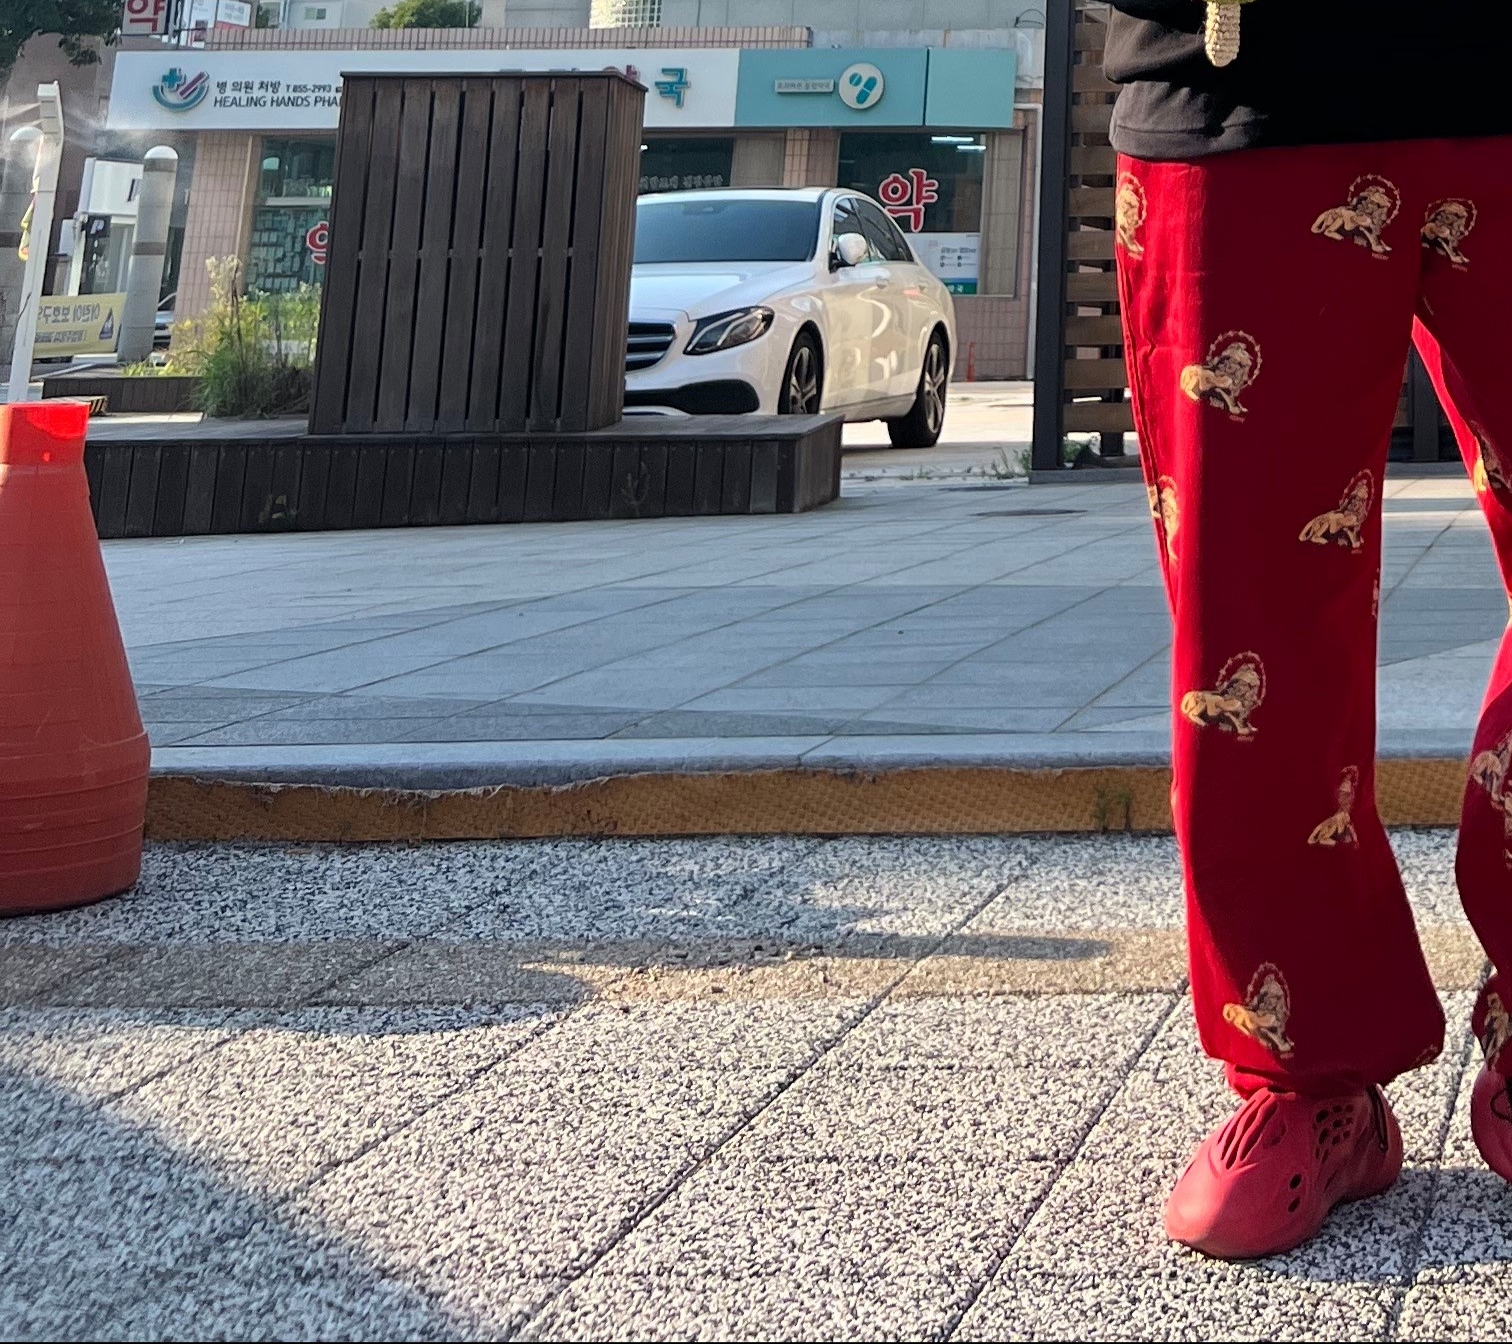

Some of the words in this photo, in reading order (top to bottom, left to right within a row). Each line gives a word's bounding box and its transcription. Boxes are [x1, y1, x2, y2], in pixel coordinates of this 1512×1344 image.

[213, 95, 267, 108] HEALING
[269, 95, 312, 108] HANDS
[313, 95, 341, 108] PHA
[654, 67, 690, 109] 국
[878, 167, 939, 233] 약
